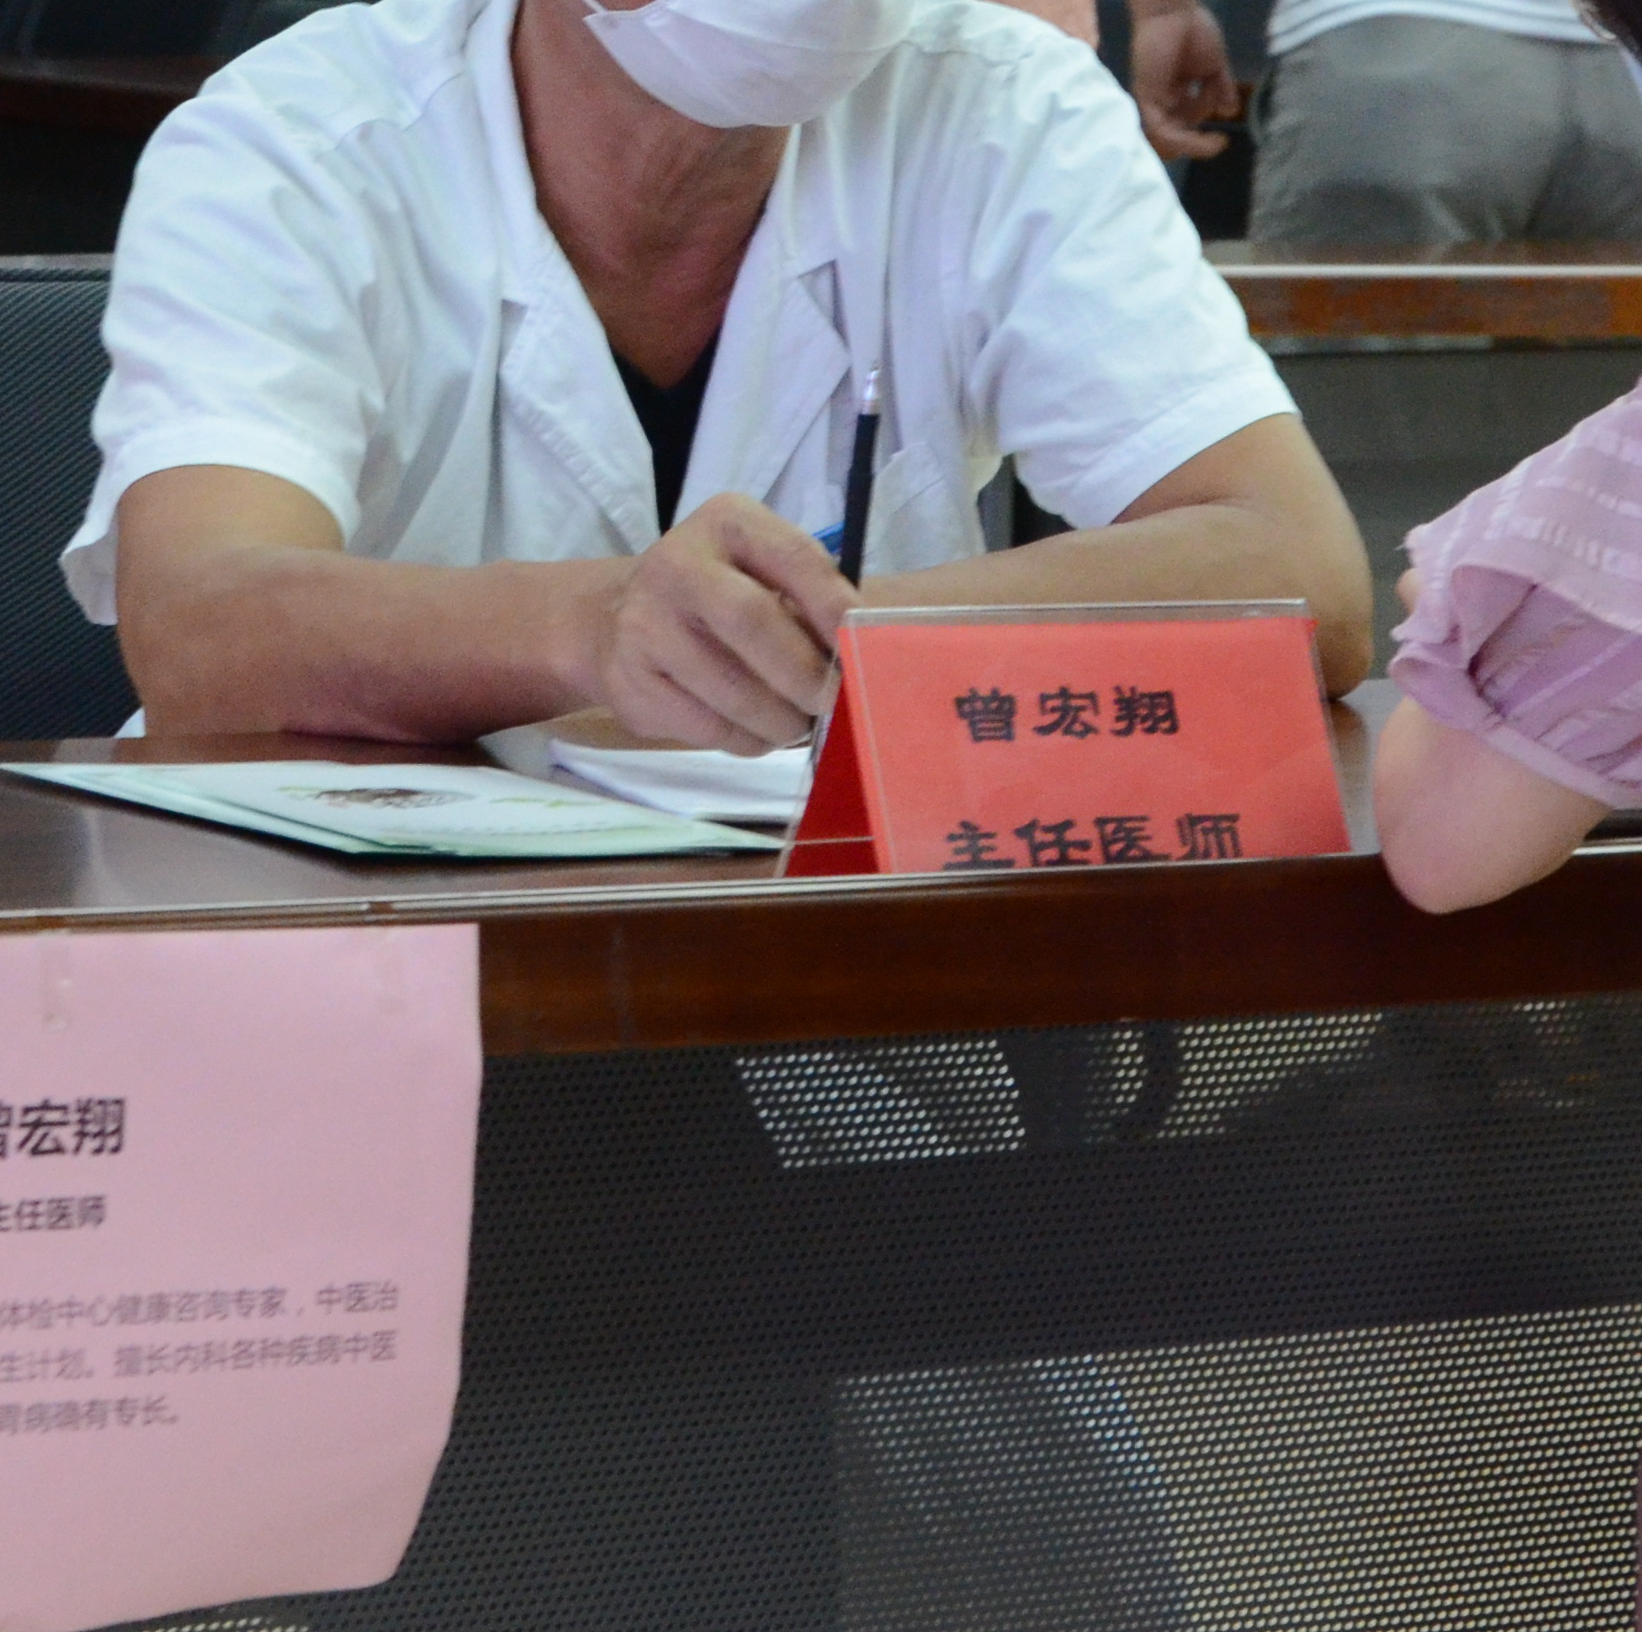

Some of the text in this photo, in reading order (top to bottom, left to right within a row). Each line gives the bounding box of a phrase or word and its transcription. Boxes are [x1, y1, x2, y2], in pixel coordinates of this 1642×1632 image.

[954, 684, 1180, 743] 曾宏翔
[941, 812, 1244, 871] 主任医师
